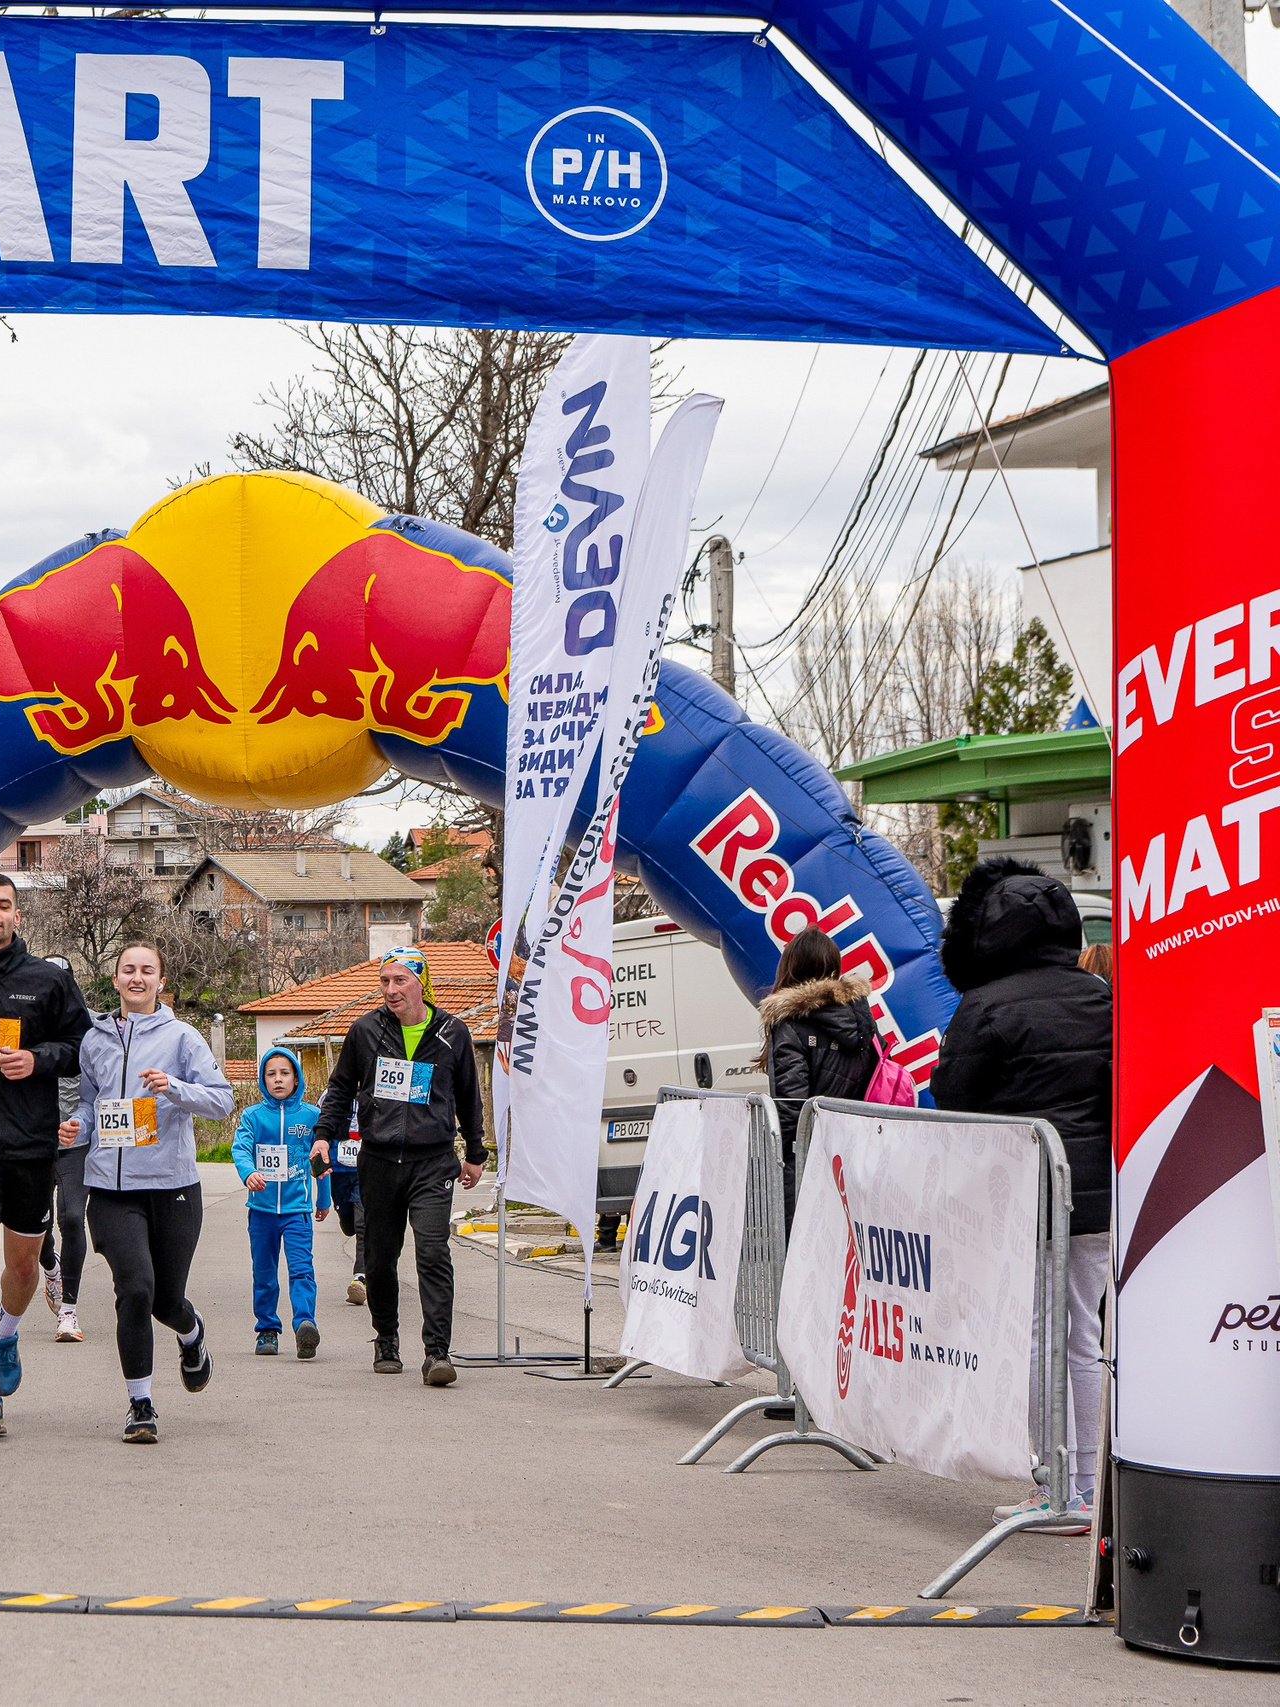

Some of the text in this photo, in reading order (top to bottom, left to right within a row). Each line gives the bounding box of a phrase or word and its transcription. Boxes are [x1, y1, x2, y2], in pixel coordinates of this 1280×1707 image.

[587, 133, 605, 143] IN
[552, 148, 641, 191] P/H
[552, 194, 641, 208] MARKOVO
[561, 380, 625, 657] DEVIN
[380, 1069, 405, 1085] 269
[99, 1113, 130, 1130] 1254
[614, 1122, 627, 1137] PB
[261, 1155, 281, 1169] 183
[909, 1314, 923, 1335] IN
[910, 1342, 979, 1372] MARKOVO
